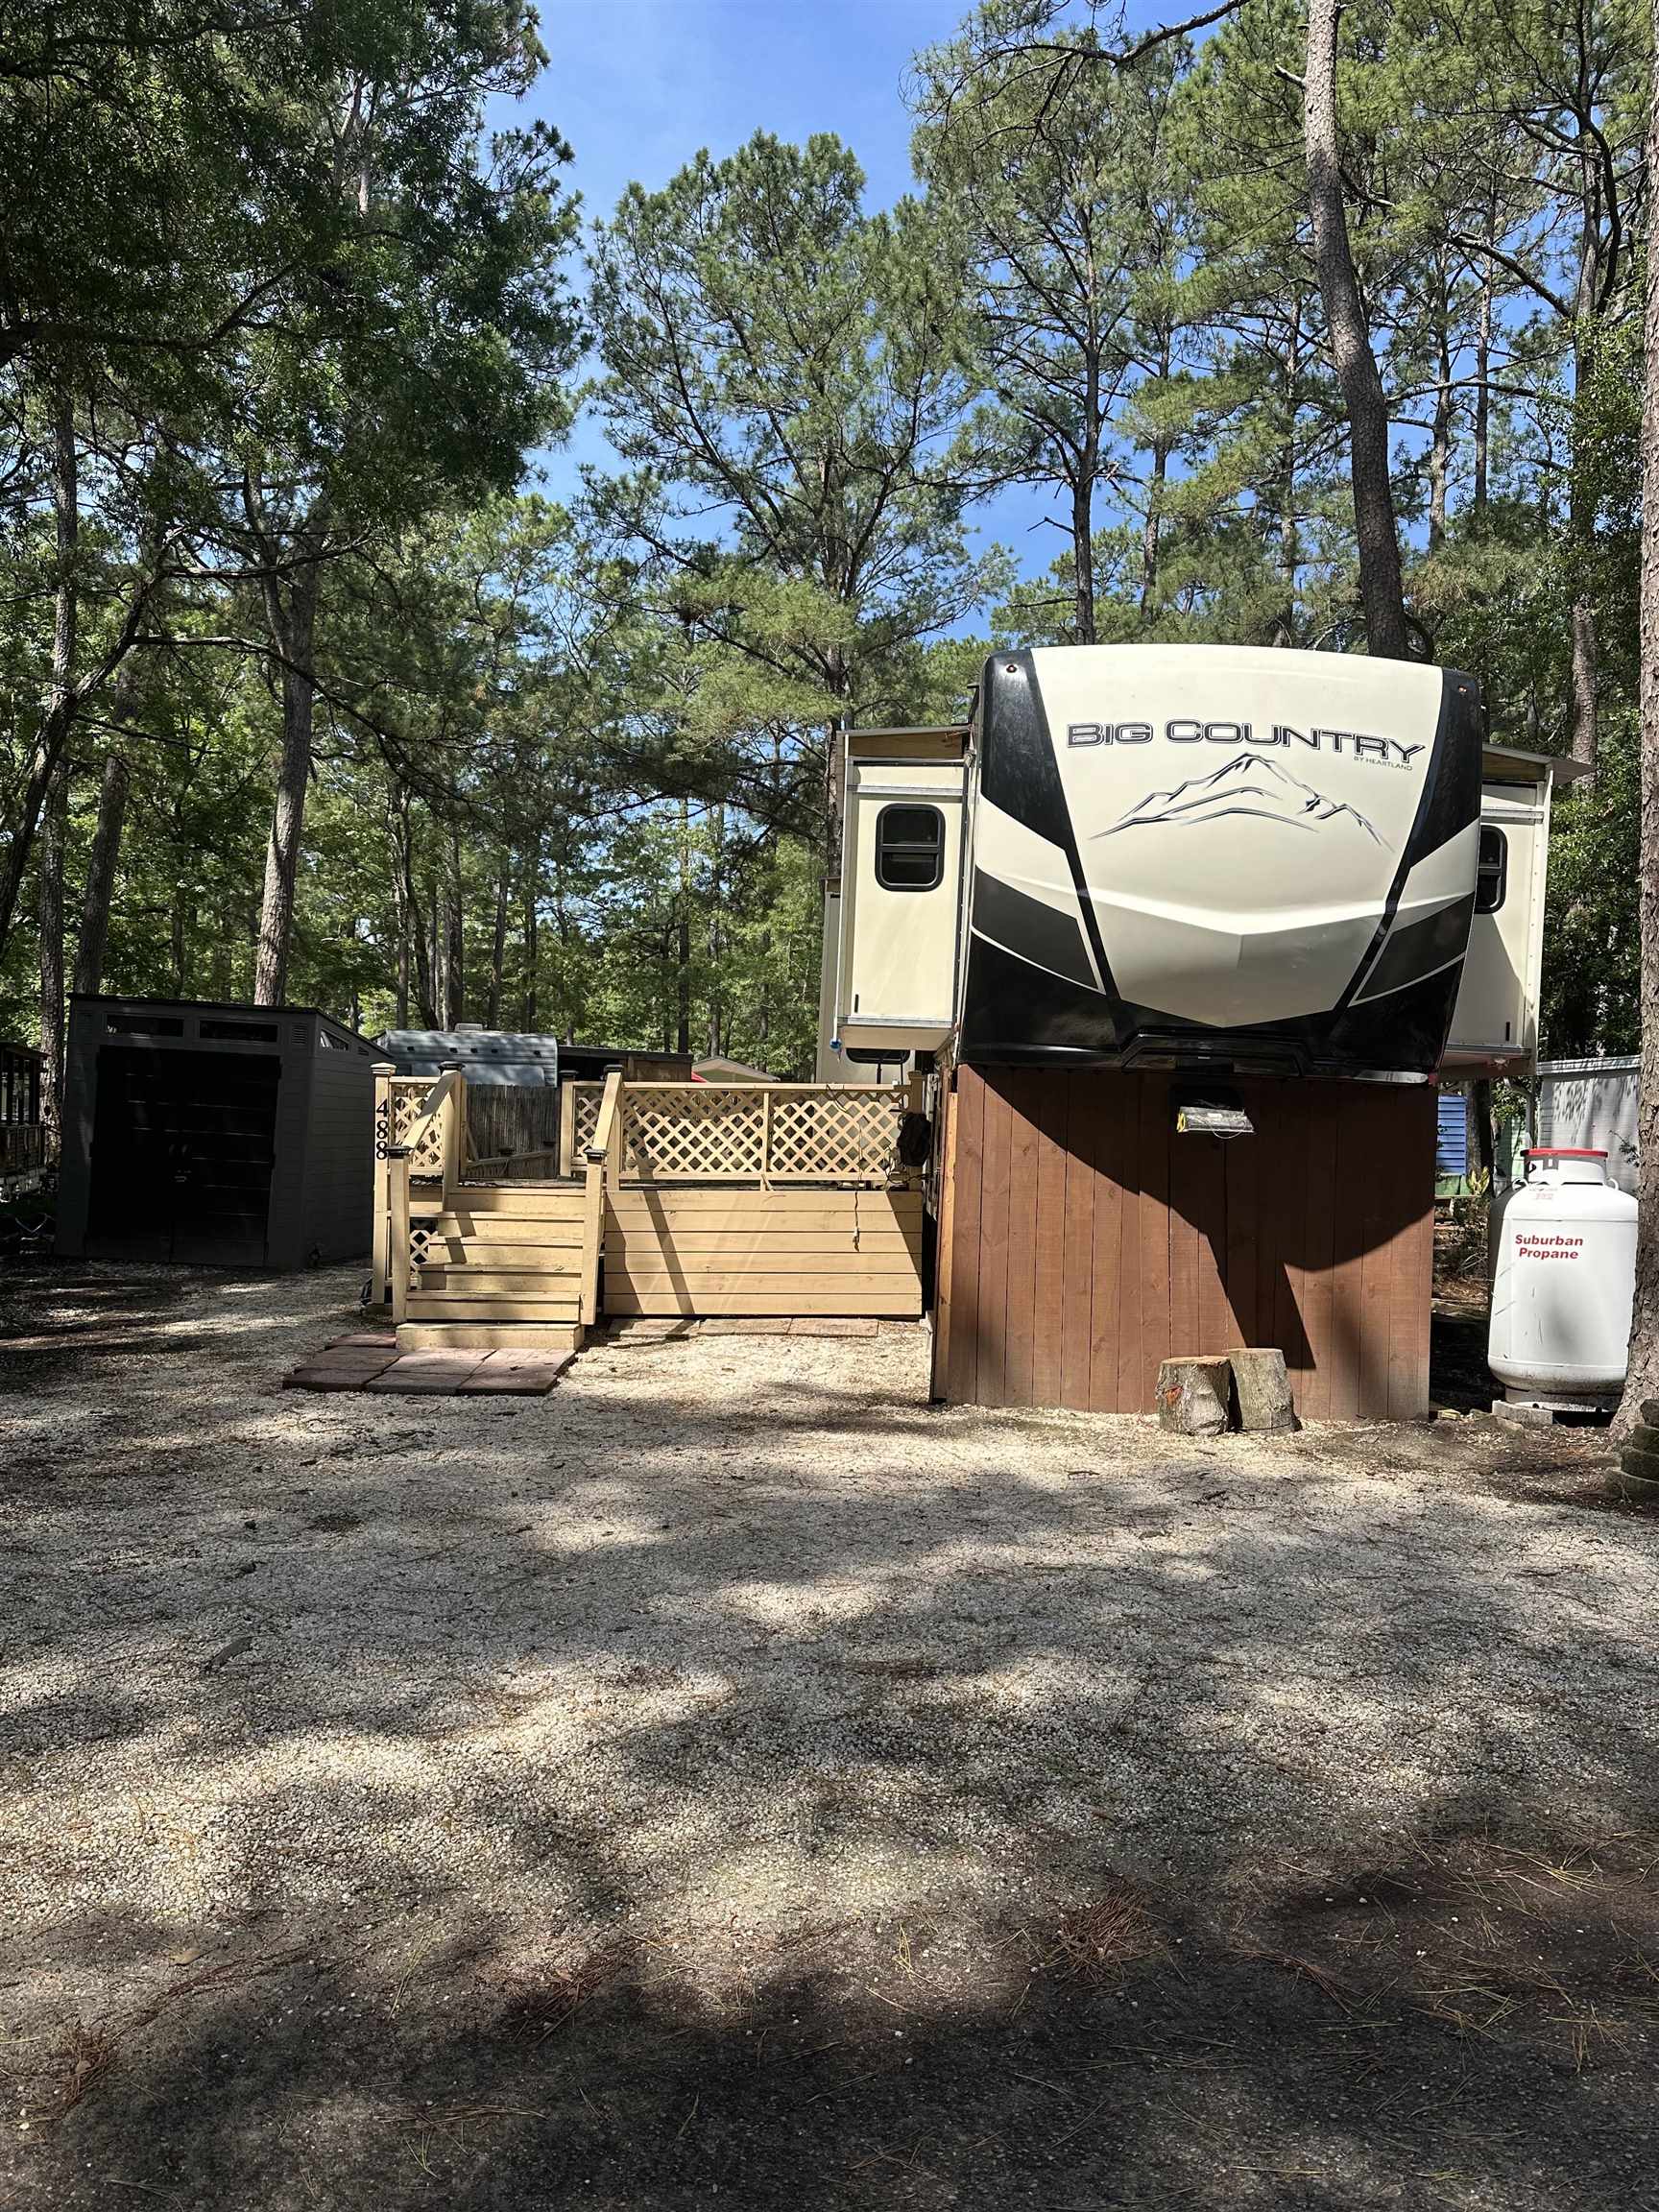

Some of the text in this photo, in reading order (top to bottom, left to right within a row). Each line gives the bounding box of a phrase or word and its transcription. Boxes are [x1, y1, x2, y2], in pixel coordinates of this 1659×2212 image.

[1067, 718, 1425, 763] BIG COUNTRY
[1365, 757, 1413, 771] HEARTLAND
[375, 1098, 389, 1160] 488
[1515, 1234, 1583, 1246] Suburban
[1519, 1247, 1579, 1260] Propane
